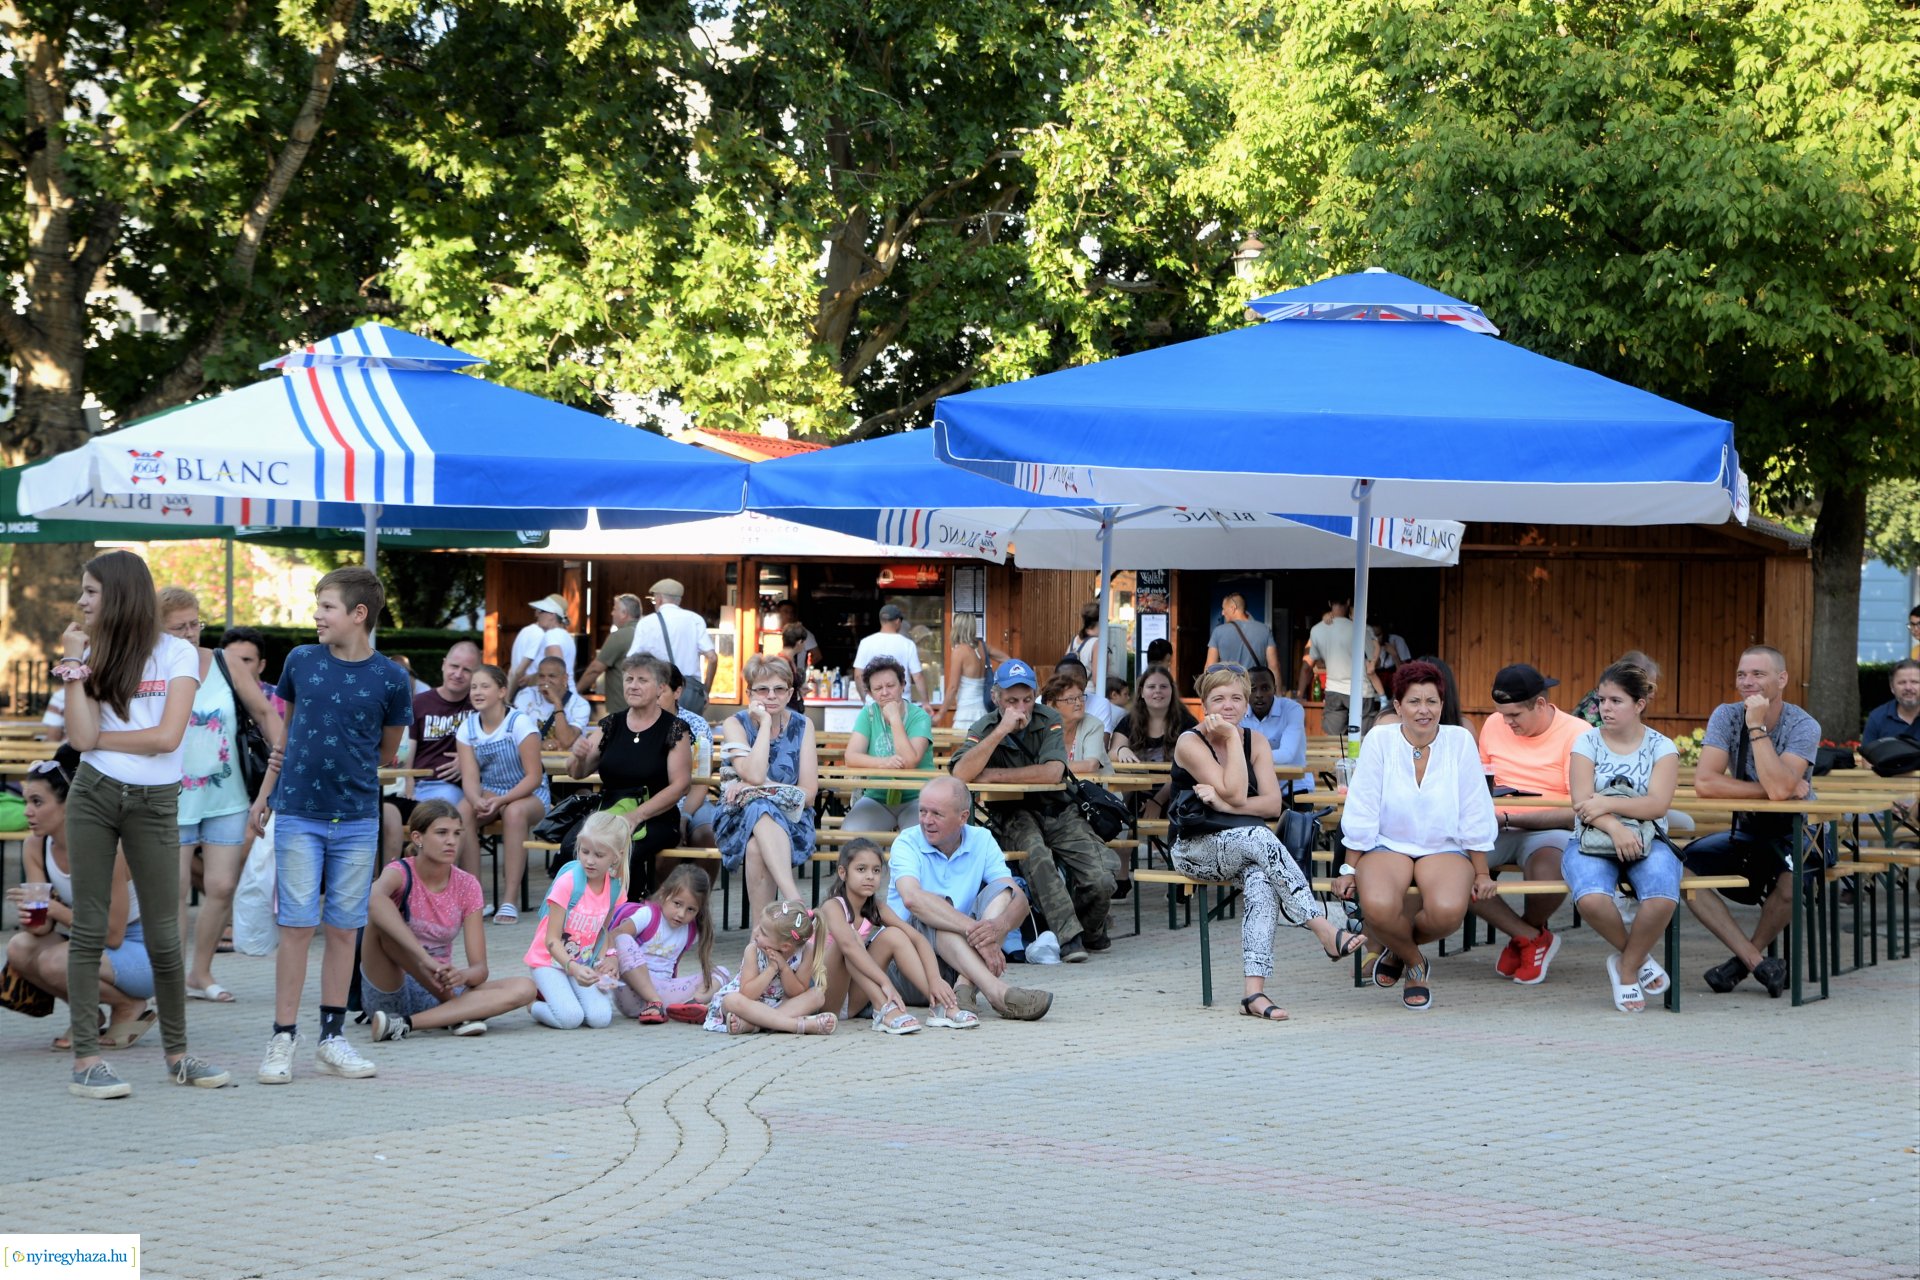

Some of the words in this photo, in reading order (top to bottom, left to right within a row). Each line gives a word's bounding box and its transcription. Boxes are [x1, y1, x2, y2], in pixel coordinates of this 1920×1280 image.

[176, 457, 289, 486] BLANC
[8, 521, 39, 533] MORE
[1416, 525, 1456, 551] BLANC
